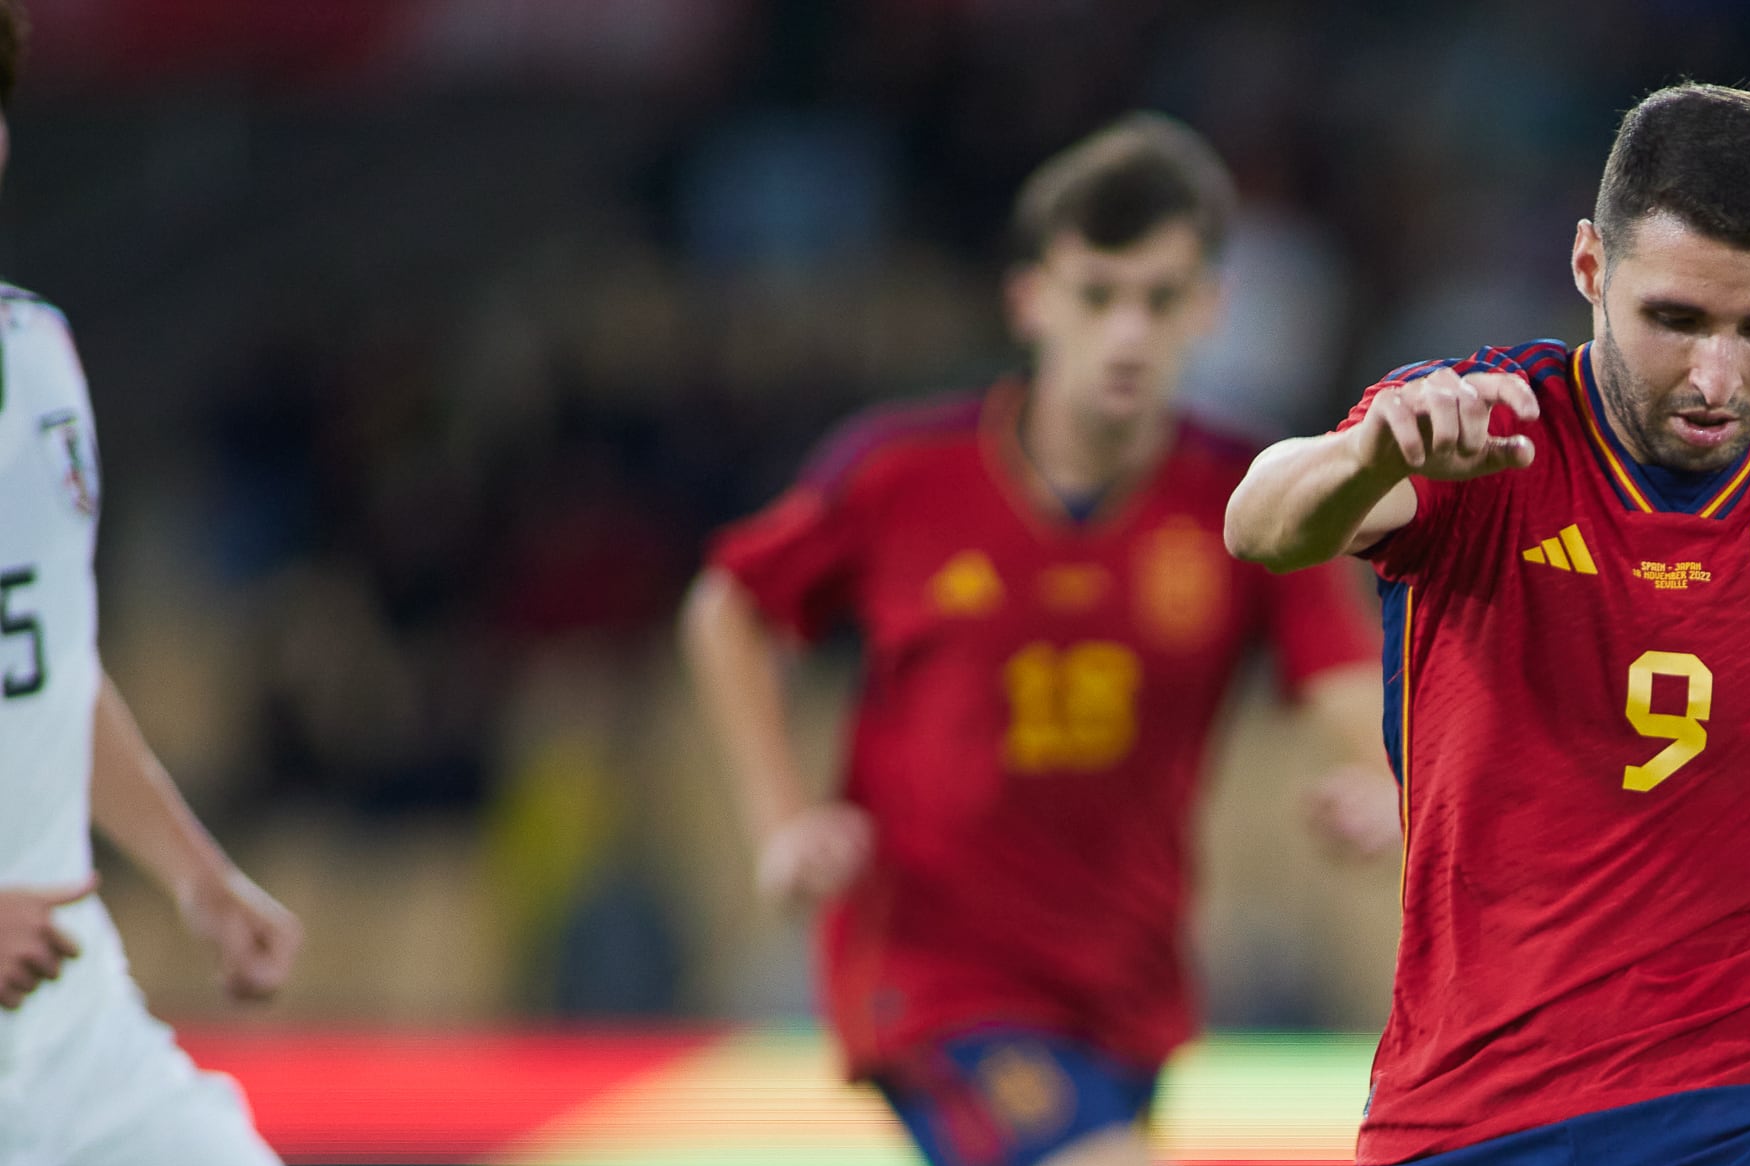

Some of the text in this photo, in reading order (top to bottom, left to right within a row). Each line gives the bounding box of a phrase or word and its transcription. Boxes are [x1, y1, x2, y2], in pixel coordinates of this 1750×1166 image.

[1641, 561, 1666, 571] SPAIN
[1675, 562, 1701, 570] JAPAN
[1644, 571, 1686, 580] NOVEMBER
[1689, 571, 1711, 581] 2022
[1655, 580, 1688, 589] SEVILLE
[1622, 651, 1713, 792] 9
